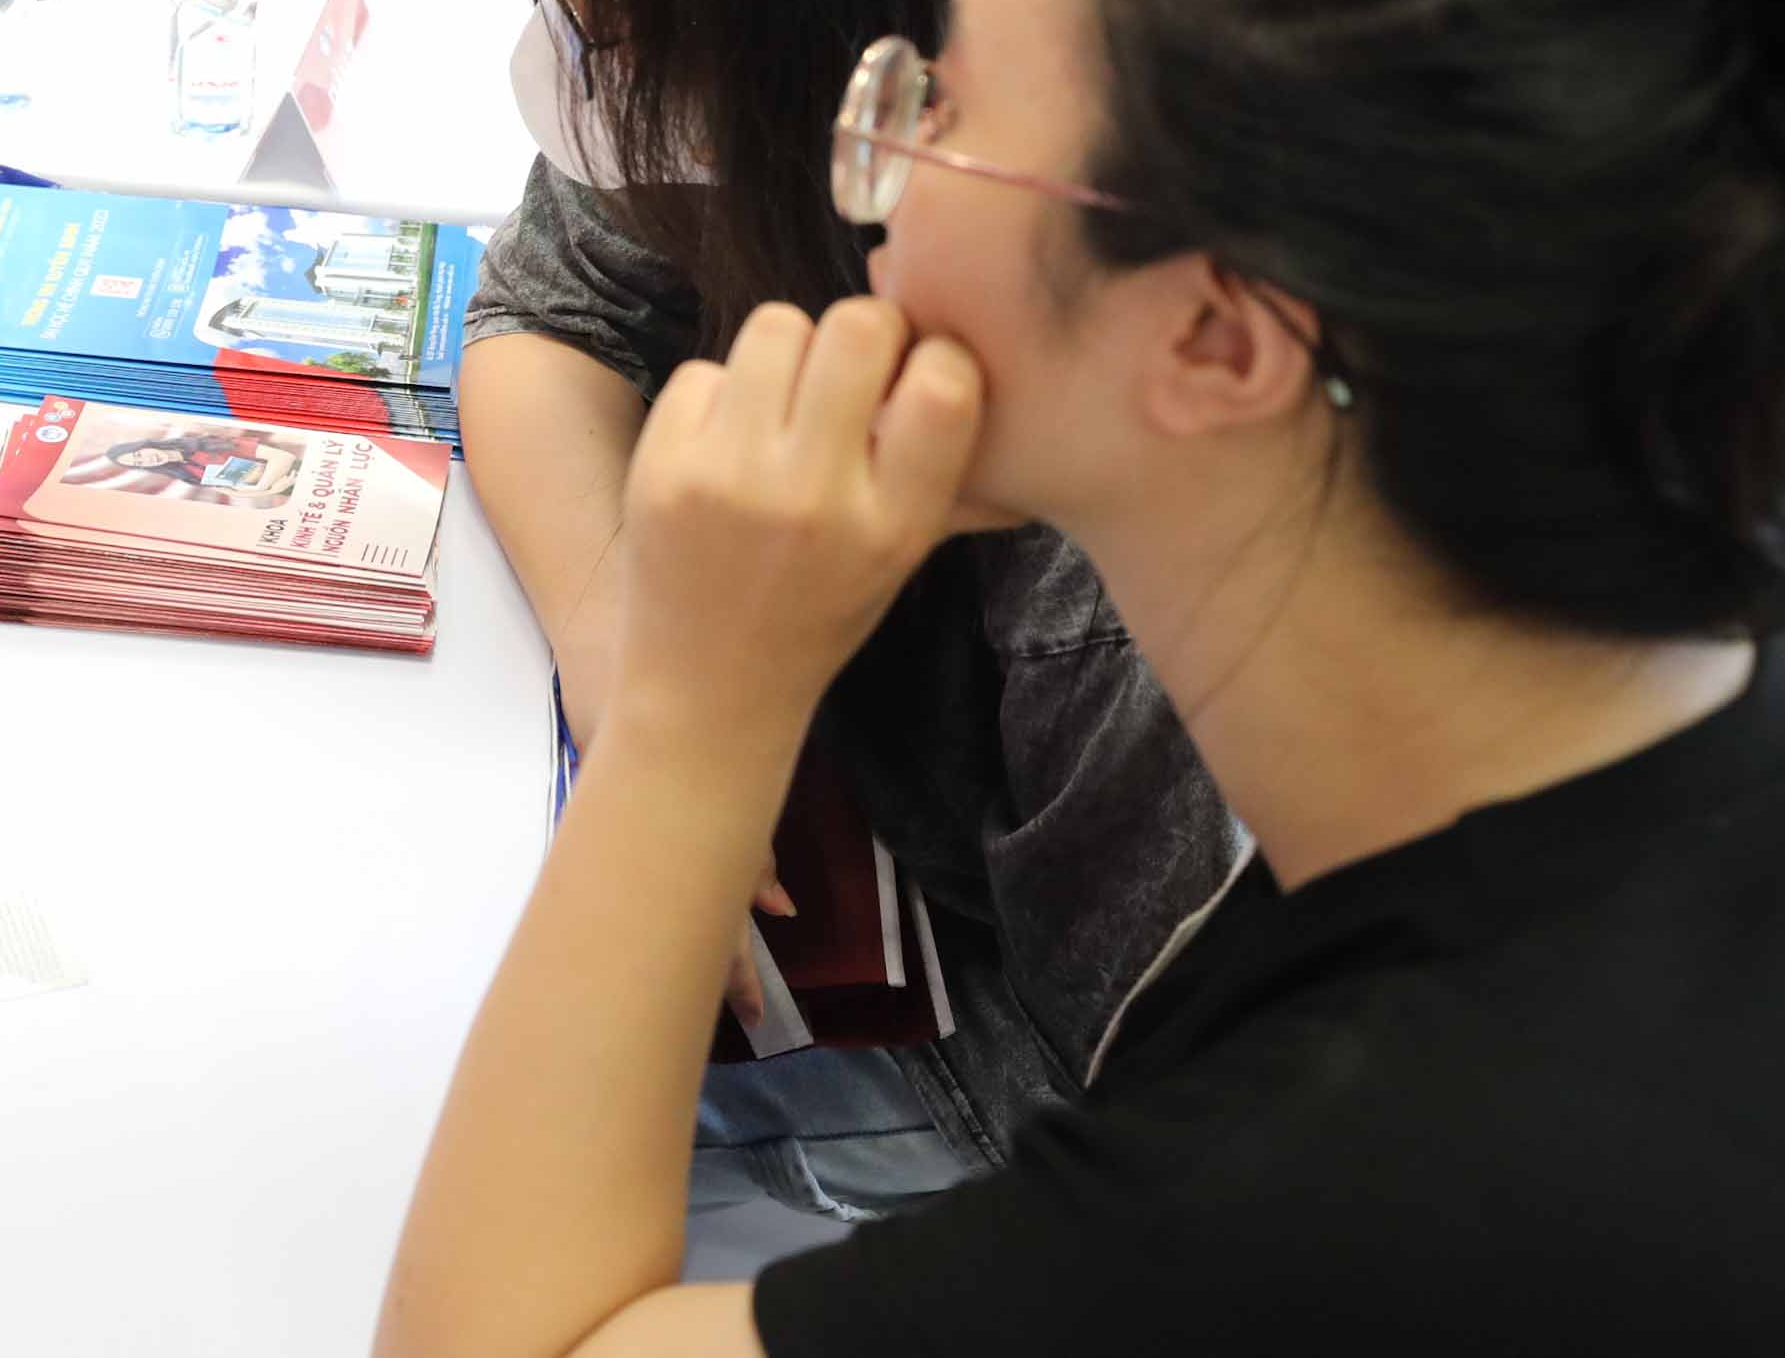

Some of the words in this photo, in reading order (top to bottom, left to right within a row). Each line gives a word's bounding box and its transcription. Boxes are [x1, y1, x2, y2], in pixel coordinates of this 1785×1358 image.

[322, 439, 345, 456] LÝ
[350, 442, 376, 470] LỰC
[311, 459, 338, 497] QUẢN
[308, 501, 326, 510] &
[337, 478, 364, 514] NHÂN
[298, 510, 323, 524] TẾ
[259, 519, 288, 544] KHOA
[290, 523, 317, 548] KINH
[321, 519, 352, 553] NGUỒN
